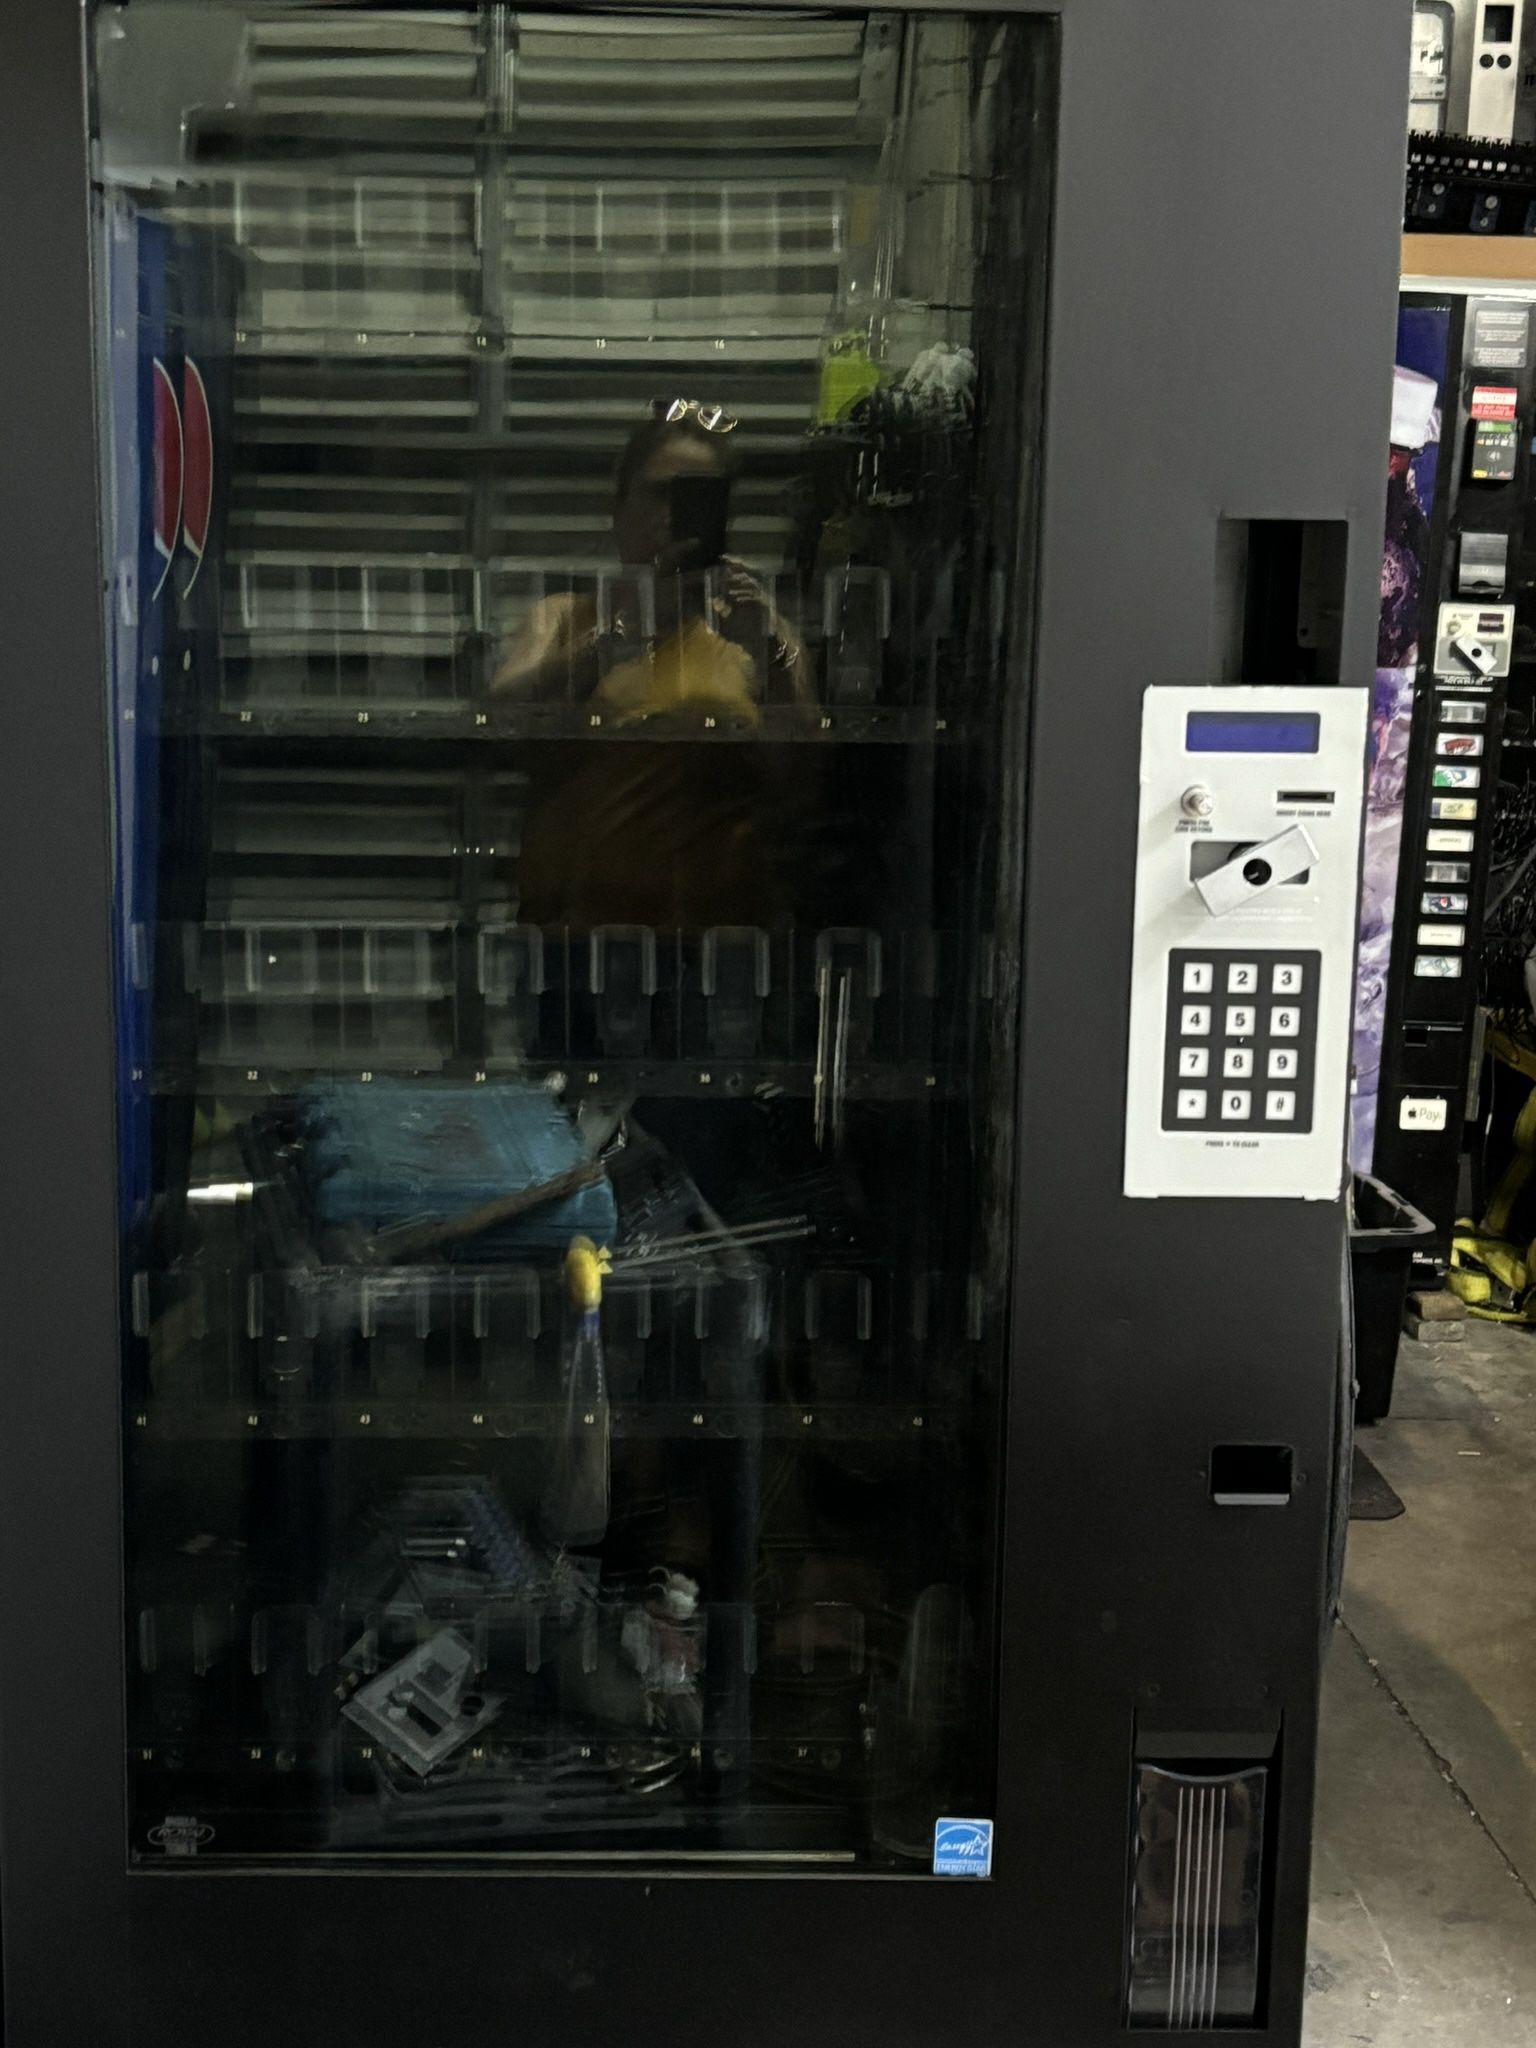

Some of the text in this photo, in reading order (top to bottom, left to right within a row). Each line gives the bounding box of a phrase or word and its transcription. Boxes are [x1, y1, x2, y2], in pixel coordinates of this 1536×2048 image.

[1193, 969, 1292, 986] 1 2 3
[1190, 1012, 1290, 1028] 4 5 6
[1188, 1054, 1288, 1070] 7 8 9
[1231, 1096, 1241, 1111] 0
[1420, 1107, 1440, 1123] Pay
